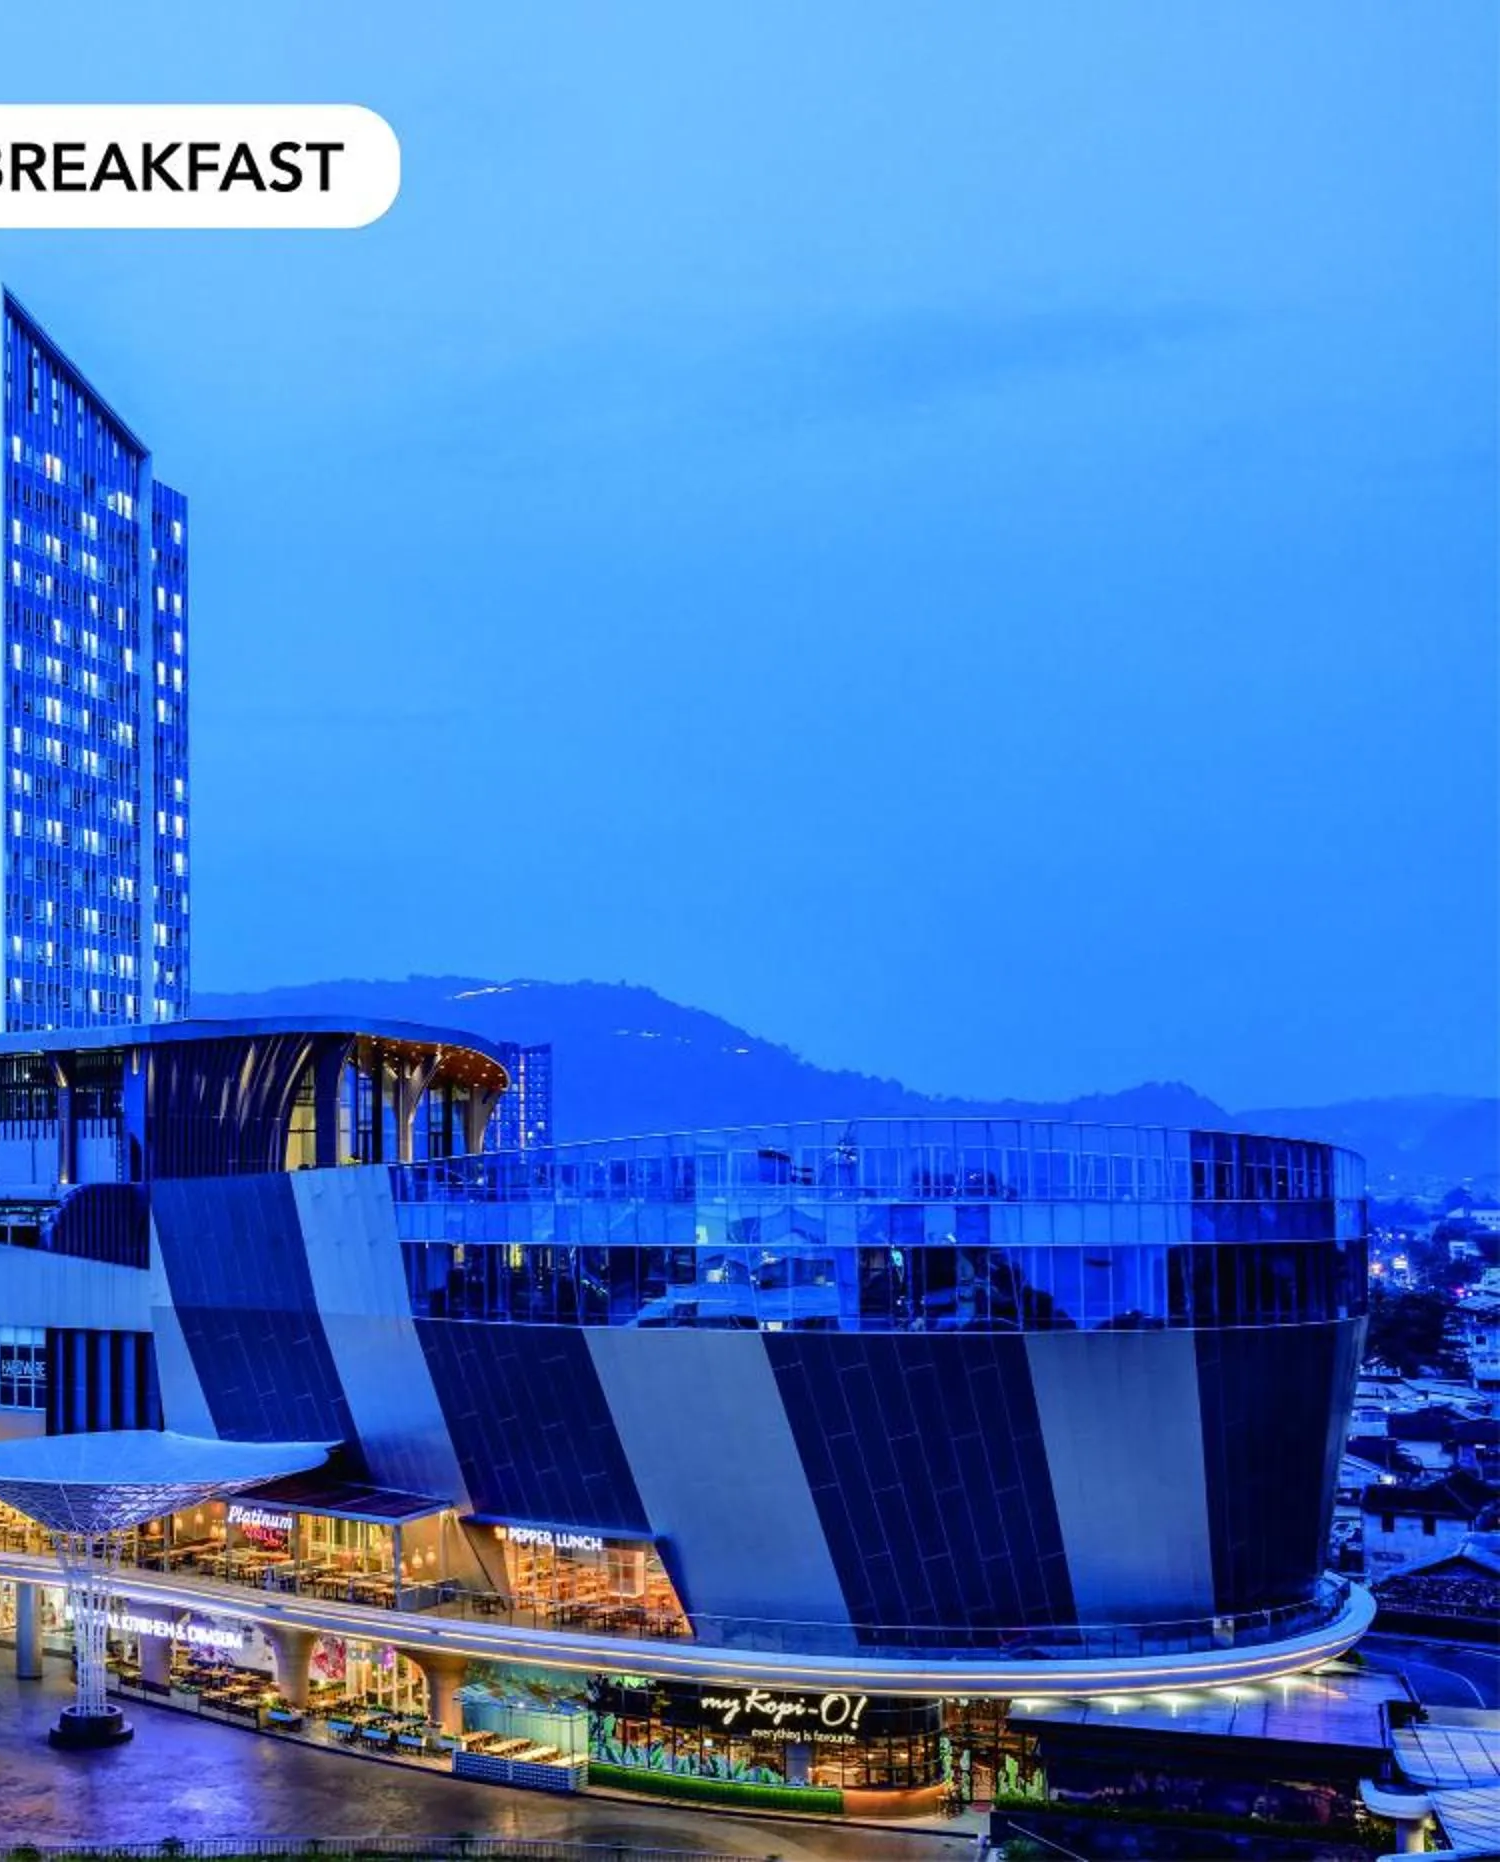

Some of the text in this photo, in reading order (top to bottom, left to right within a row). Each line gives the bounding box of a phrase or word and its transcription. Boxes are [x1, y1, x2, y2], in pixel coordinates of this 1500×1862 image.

[228, 1505, 293, 1529] Platinum
[508, 1527, 603, 1551] PEPPER LUNCH
[175, 1621, 188, 1641] &
[700, 1697, 741, 1725] my
[751, 1728, 801, 1744] everything
[803, 1729, 813, 1742] is
